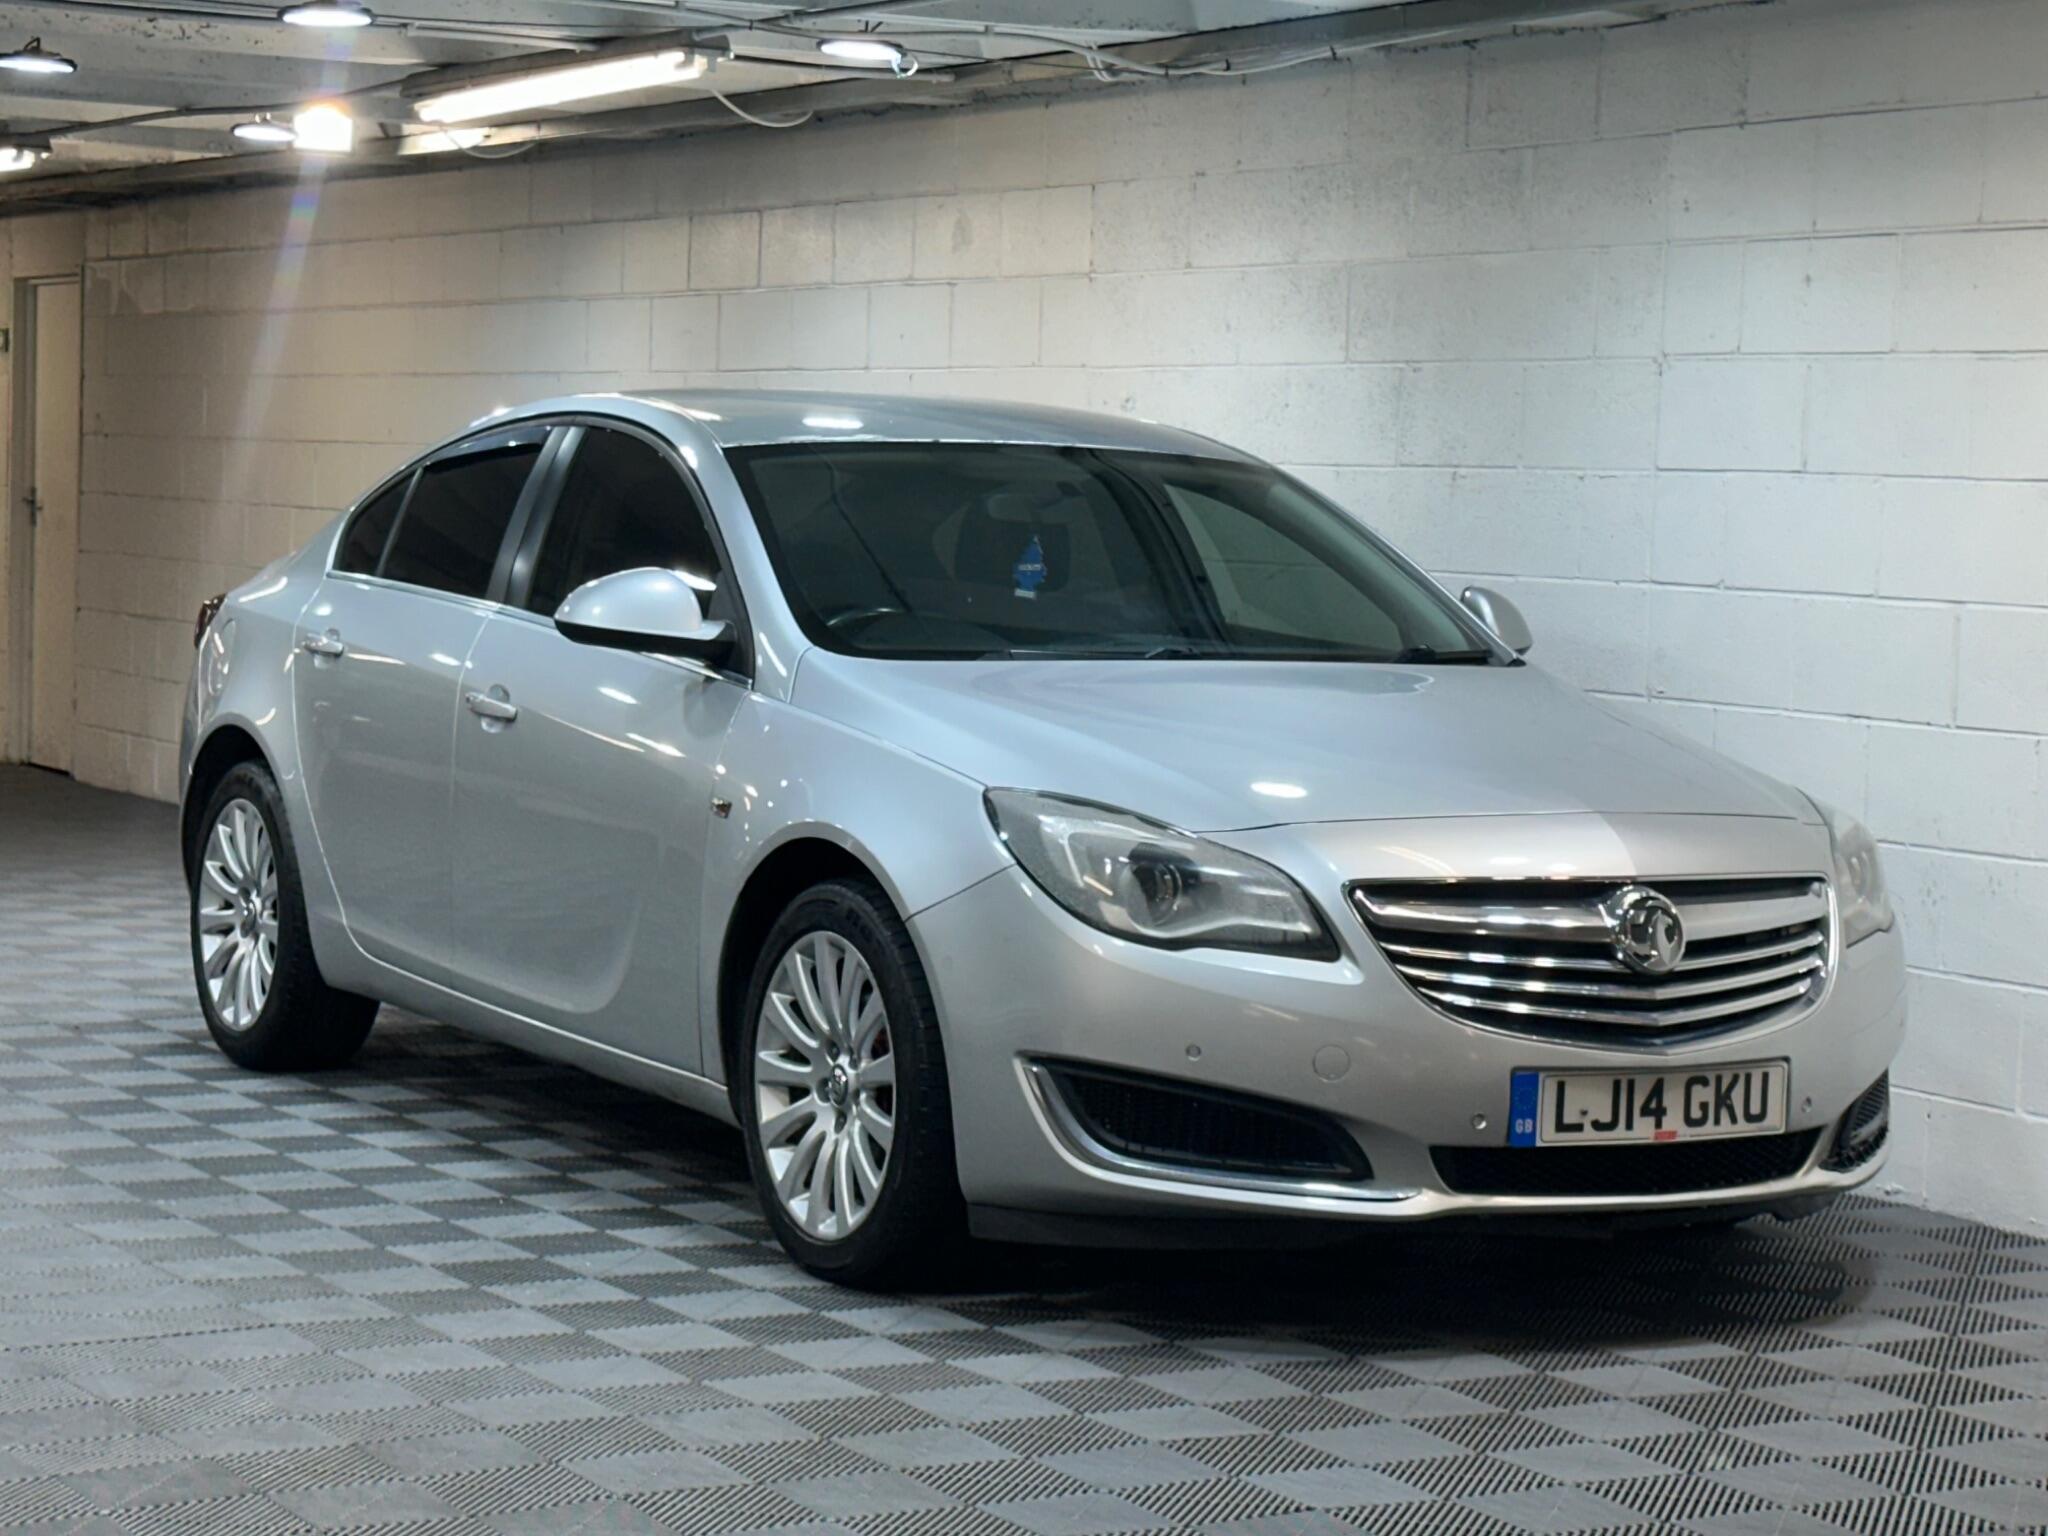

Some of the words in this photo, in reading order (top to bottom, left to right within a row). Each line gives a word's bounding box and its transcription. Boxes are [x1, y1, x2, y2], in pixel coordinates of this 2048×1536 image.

[1555, 1077, 1667, 1133] LJ14
[1683, 1071, 1769, 1128] GKU
[1515, 1118, 1533, 1134] GB
